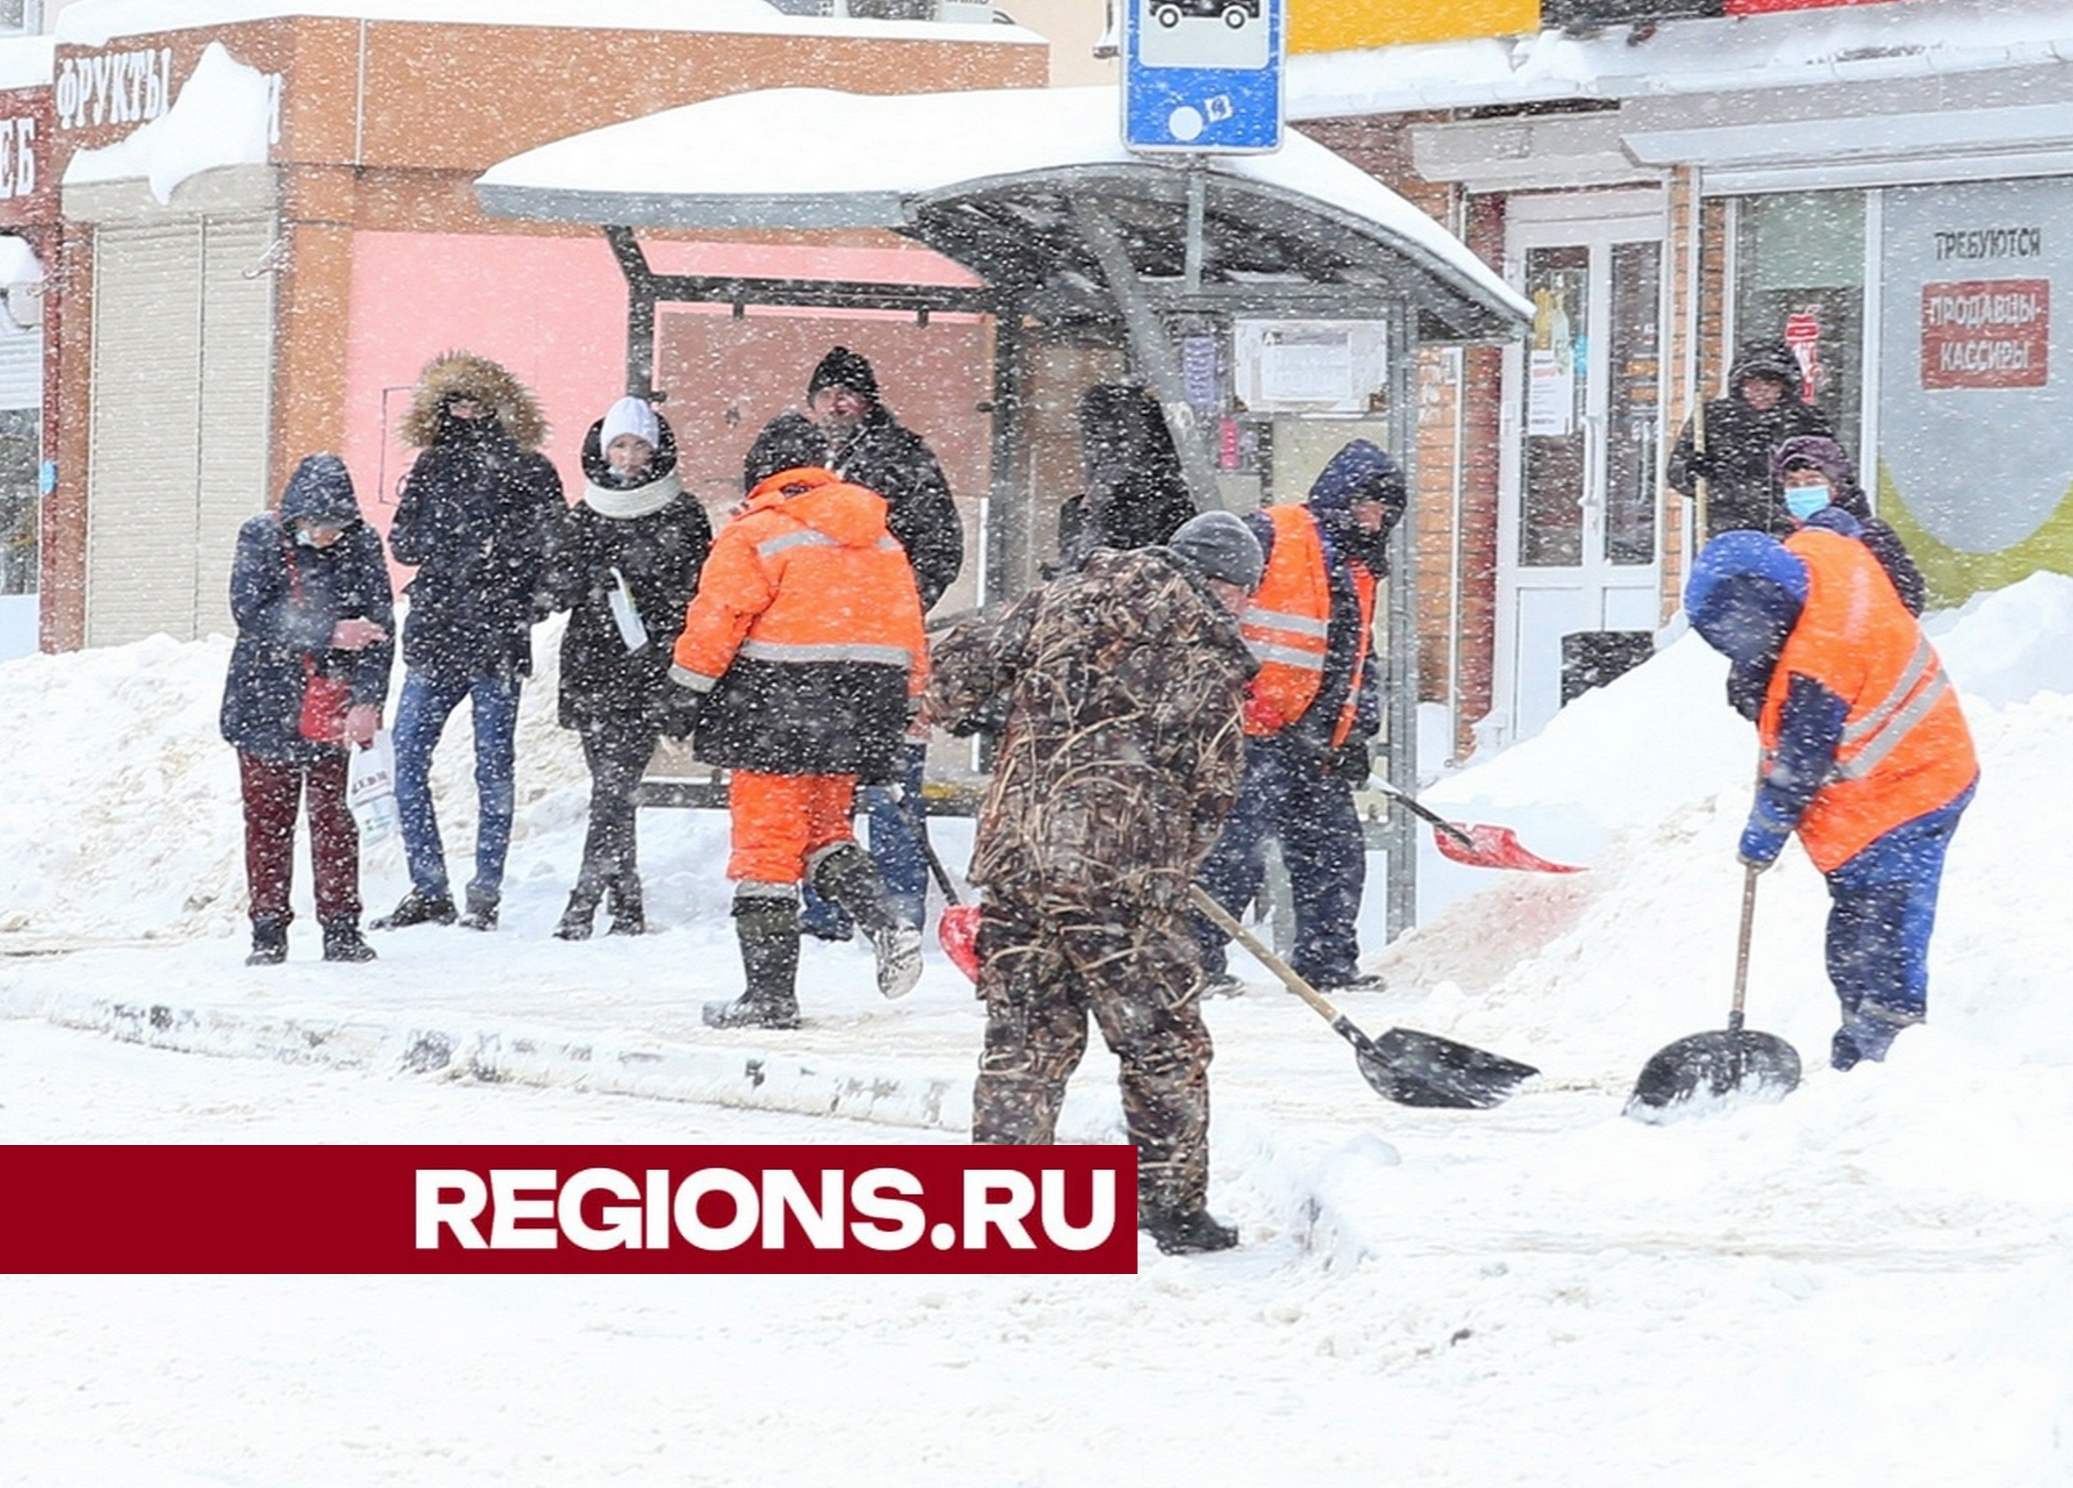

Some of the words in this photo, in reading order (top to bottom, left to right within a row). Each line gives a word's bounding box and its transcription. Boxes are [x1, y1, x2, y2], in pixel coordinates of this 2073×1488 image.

[57, 48, 171, 130] ФРУКТЫ
[1934, 228, 2041, 260] ТРЕБУЮТСЯ
[1932, 293, 2036, 328] ПРОДАВЦЫ
[1941, 341, 2029, 371] КАССИРЫ
